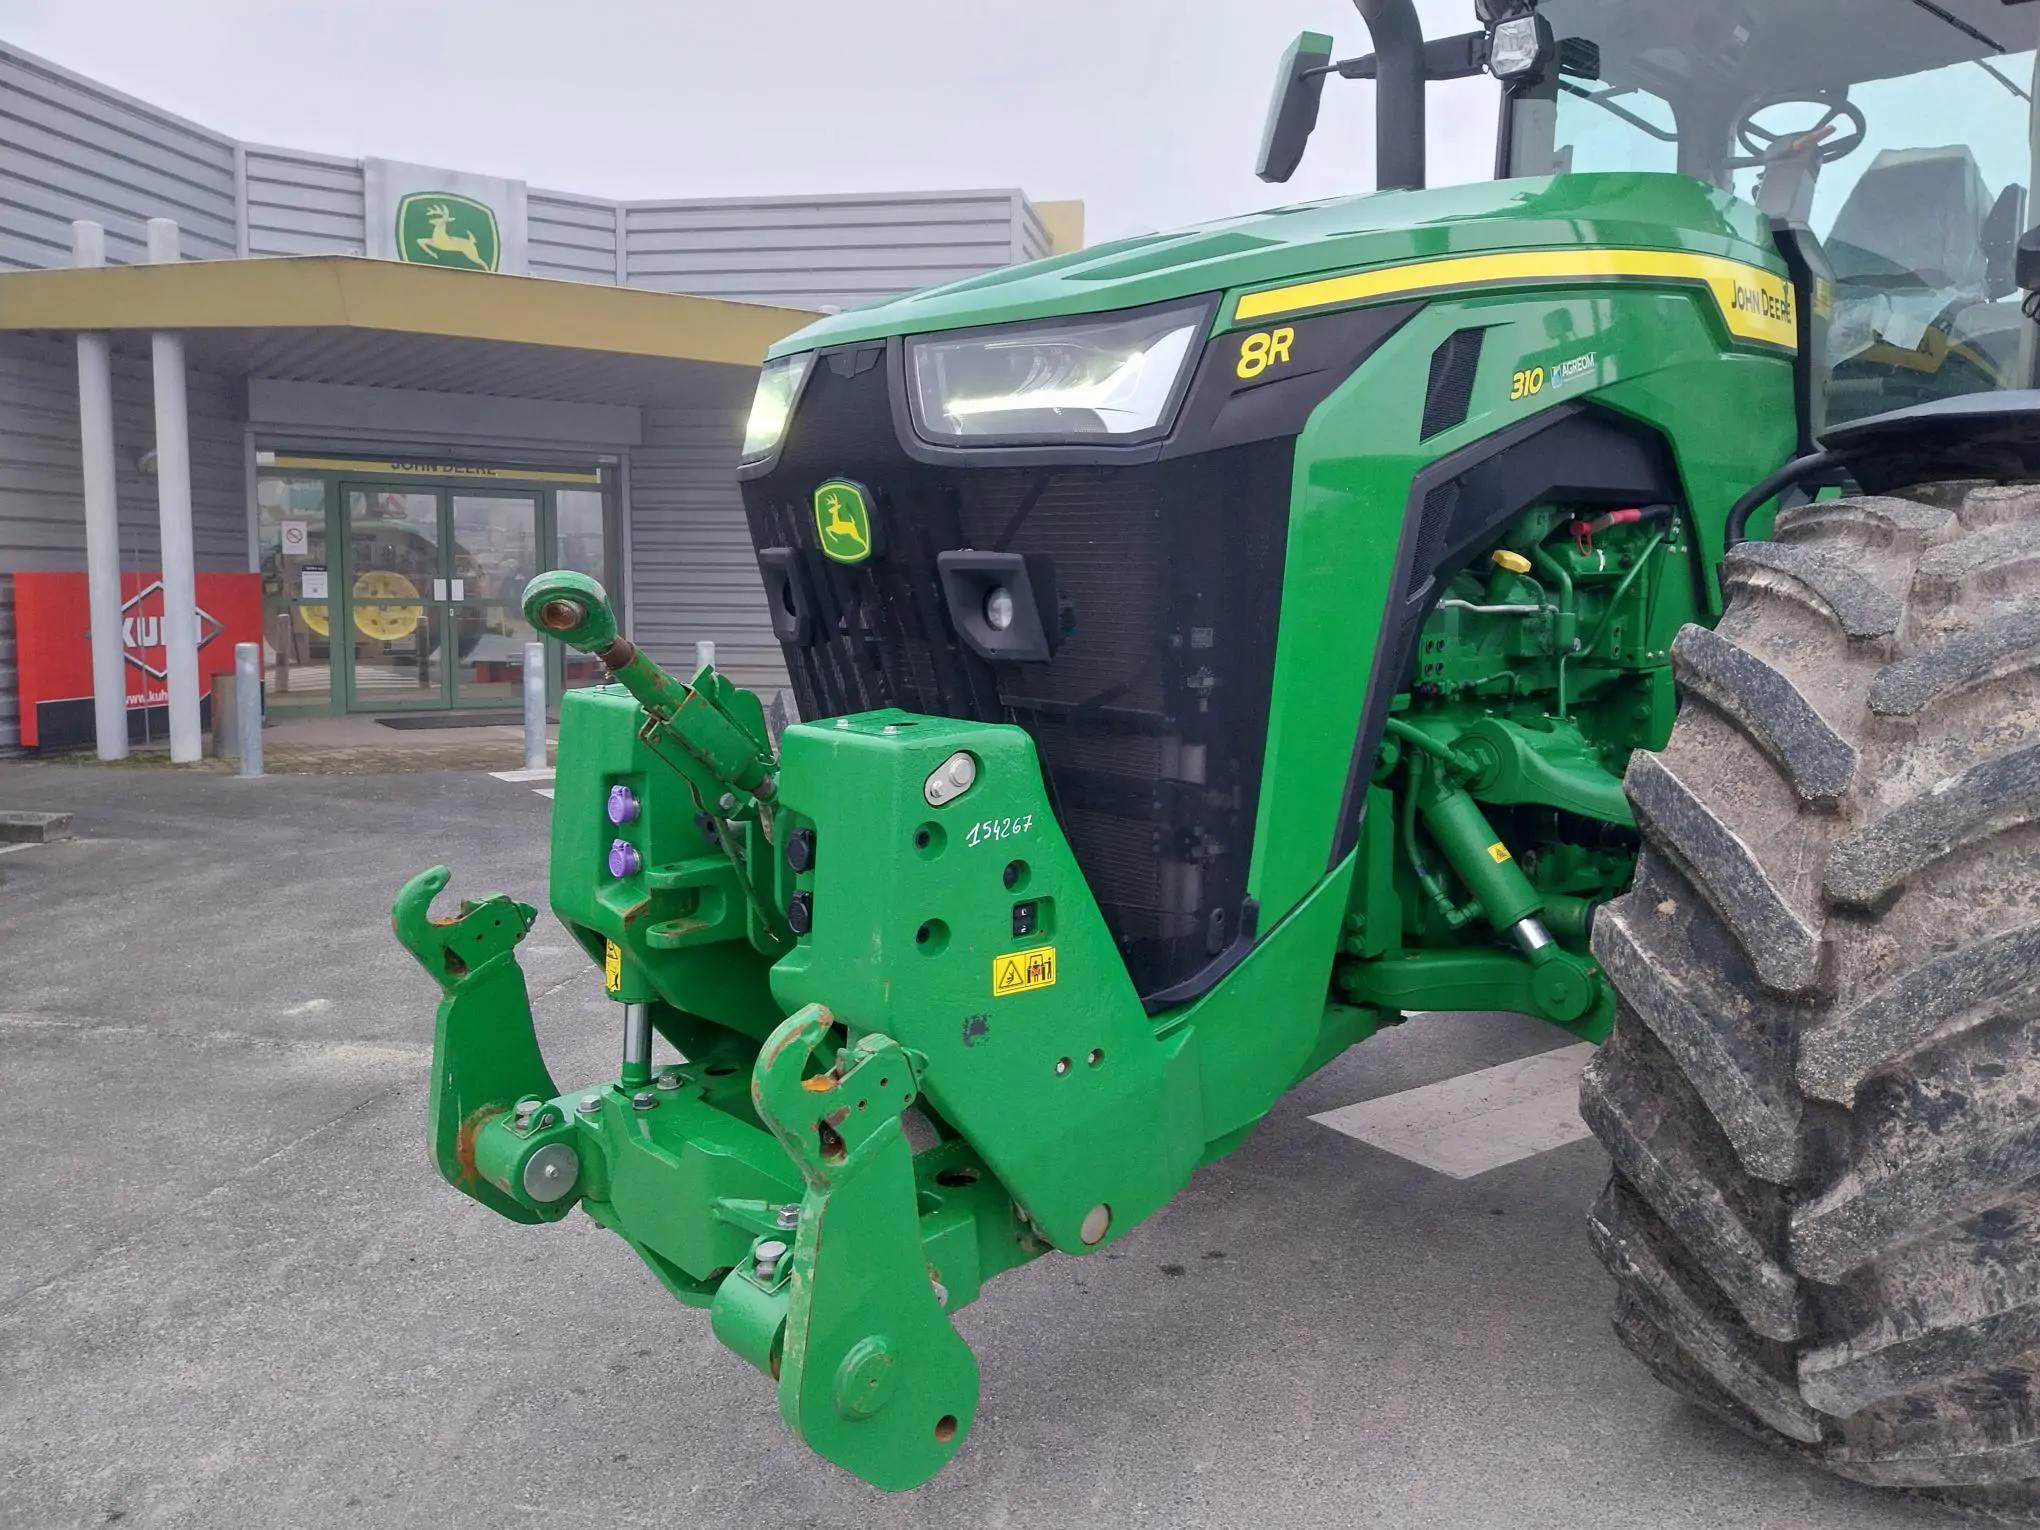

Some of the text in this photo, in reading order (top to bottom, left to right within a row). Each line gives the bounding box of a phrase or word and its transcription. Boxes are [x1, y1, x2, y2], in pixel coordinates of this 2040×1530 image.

[1731, 280, 1791, 324] JOHN DEERE
[1237, 327, 1295, 378] 8R
[1562, 352, 1596, 377] AGREOM
[1510, 366, 1544, 401] 310
[965, 814, 1033, 848] 154267
